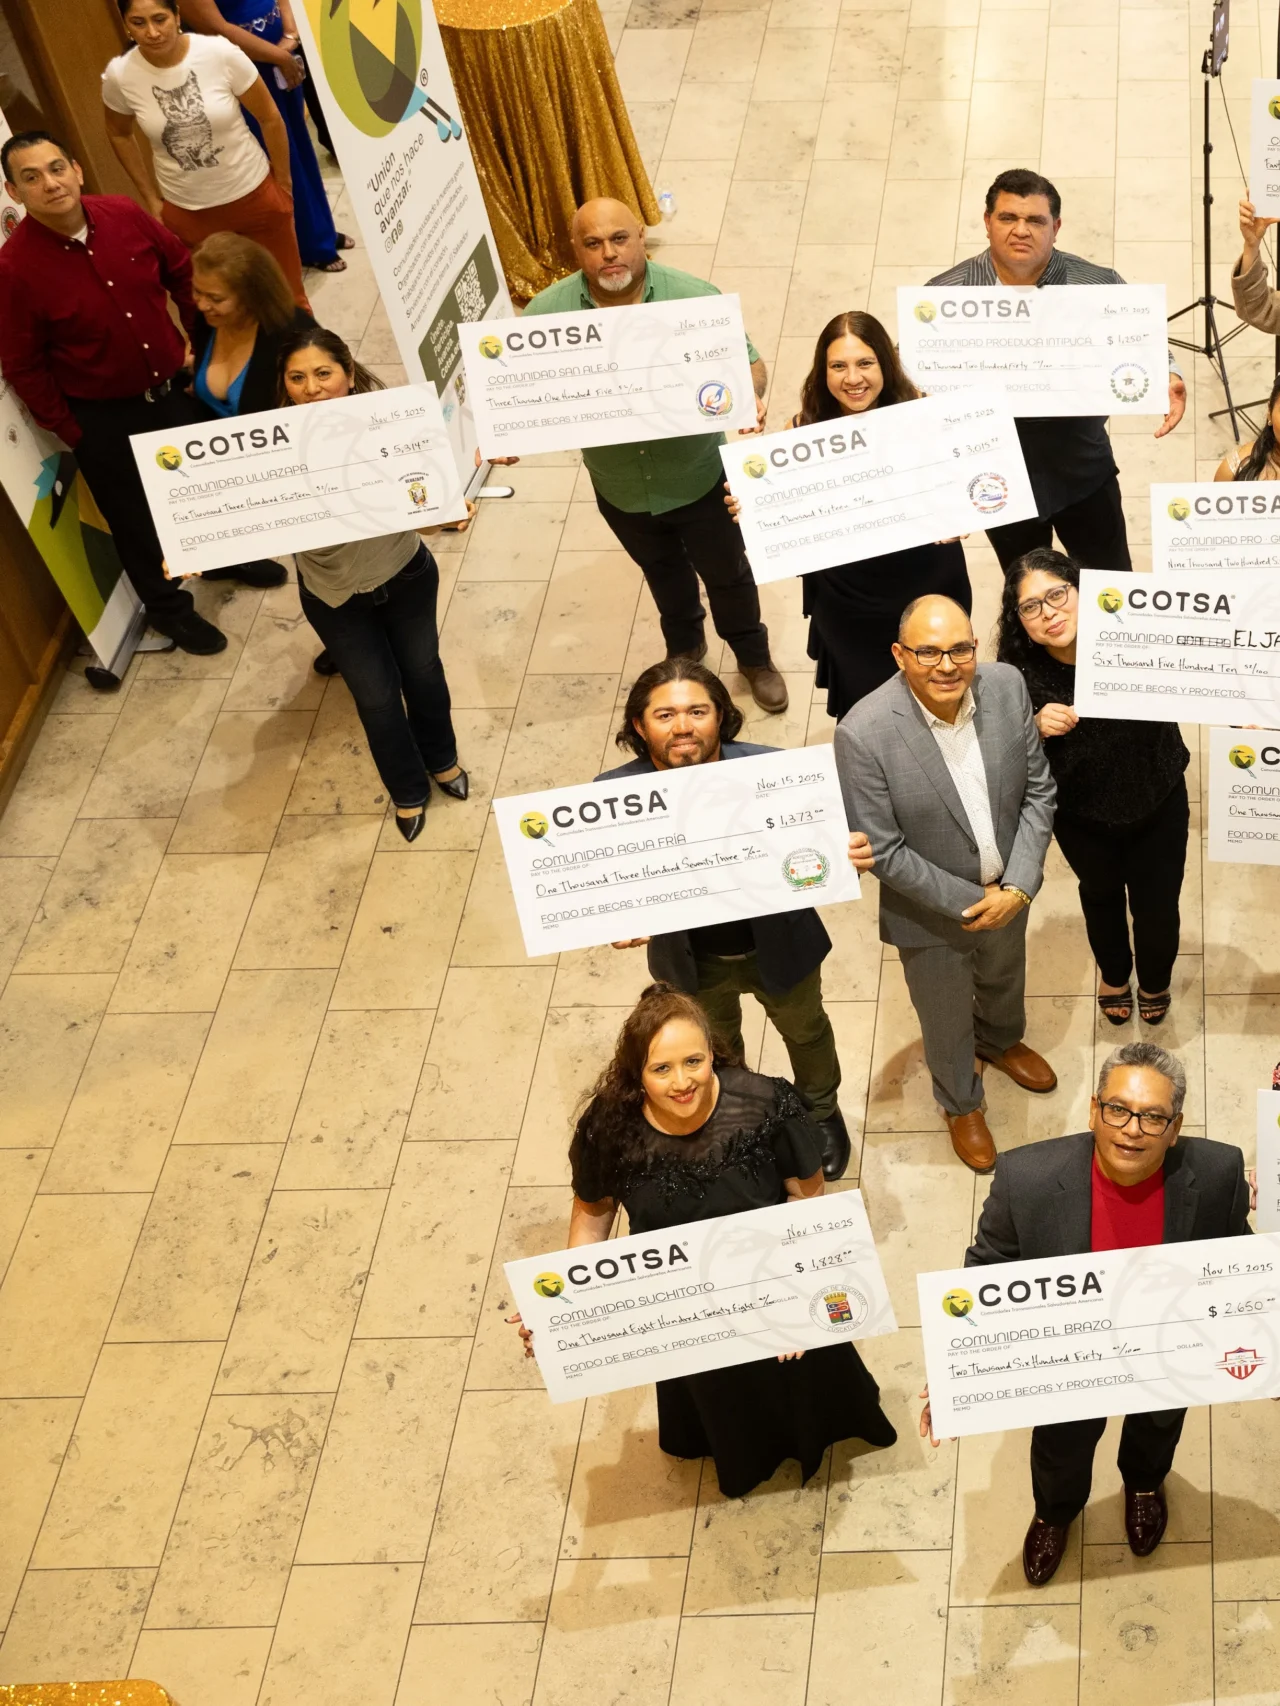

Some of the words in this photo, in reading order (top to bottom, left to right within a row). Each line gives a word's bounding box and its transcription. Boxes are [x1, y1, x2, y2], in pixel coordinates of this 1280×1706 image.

[374, 187, 391, 216] que
[391, 163, 405, 191] nos
[403, 133, 424, 167] hace
[940, 299, 1030, 318] COTSA
[506, 324, 602, 352] COTSA
[918, 338, 983, 348] COMUNIDAD
[986, 337, 1044, 348] PROEDUCA
[487, 369, 557, 385] COMUNIDAD
[558, 367, 581, 378] SAN
[582, 362, 619, 375] ALEJO
[185, 425, 290, 460] COTSA
[770, 430, 867, 468] COTSA
[169, 476, 245, 499] COMUNIDAD
[245, 463, 310, 484] ULUAZAPA
[754, 482, 825, 506] COMUNIDAD
[826, 479, 841, 489] EL
[842, 465, 894, 485] PICACHO
[179, 533, 216, 547] FONDO
[216, 529, 231, 540] DE
[231, 523, 266, 537] BECAS
[265, 522, 275, 530] Y
[274, 510, 332, 529] PROYECTOS
[1171, 535, 1238, 547] COMUNIDAD
[1240, 535, 1263, 544] PRO
[1128, 589, 1231, 615] COTSA
[1099, 631, 1174, 645] COMUNIDAD
[1234, 629, 1255, 648] EL
[552, 790, 667, 828] COTSA
[532, 846, 615, 870] COMUNIDAD
[617, 839, 655, 855] AGUA
[657, 833, 687, 848] FRÍA
[787, 1224, 807, 1240] Nov
[812, 1223, 824, 1234] 15
[828, 1218, 853, 1230] 2025
[567, 1244, 689, 1286] COTSA
[1203, 1262, 1223, 1277] Nov
[1228, 1264, 1240, 1274] 15
[1246, 1263, 1273, 1272] 2025
[549, 1299, 637, 1325] COMUNIDAD
[638, 1282, 716, 1306] SUCHITOTO
[978, 1271, 1102, 1307] COTSA
[950, 1328, 1041, 1349] COMUNIDAD
[1043, 1326, 1060, 1337] EL
[1064, 1319, 1113, 1335] BRAZO
[1176, 1342, 1204, 1350] DOLLARS
[952, 1391, 994, 1406] FONDO
[996, 1389, 1013, 1400] DE
[1014, 1383, 1053, 1397] BECAS
[1055, 1382, 1065, 1393] Y
[1066, 1373, 1134, 1391] PROYECTOS
